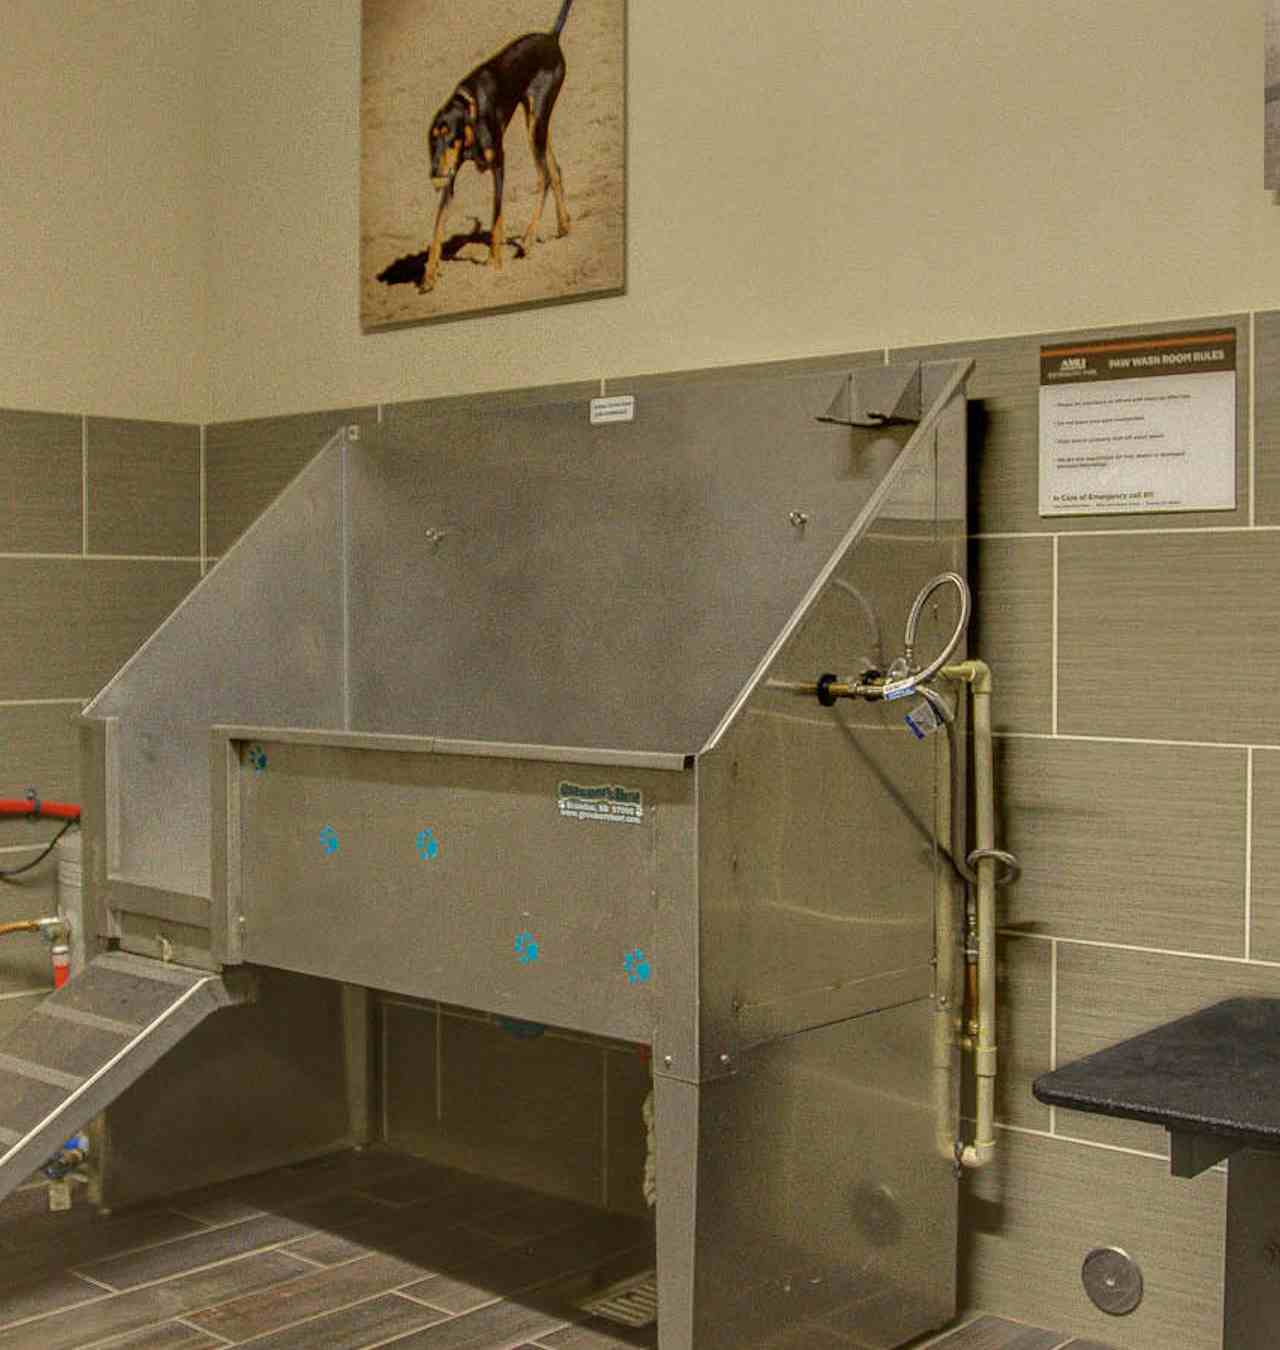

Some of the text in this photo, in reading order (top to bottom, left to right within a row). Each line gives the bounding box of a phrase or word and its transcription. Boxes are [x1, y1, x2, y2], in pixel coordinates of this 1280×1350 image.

[1132, 356, 1161, 367] WASH
[1162, 353, 1192, 365] ROOM
[1193, 350, 1225, 362] RULES
